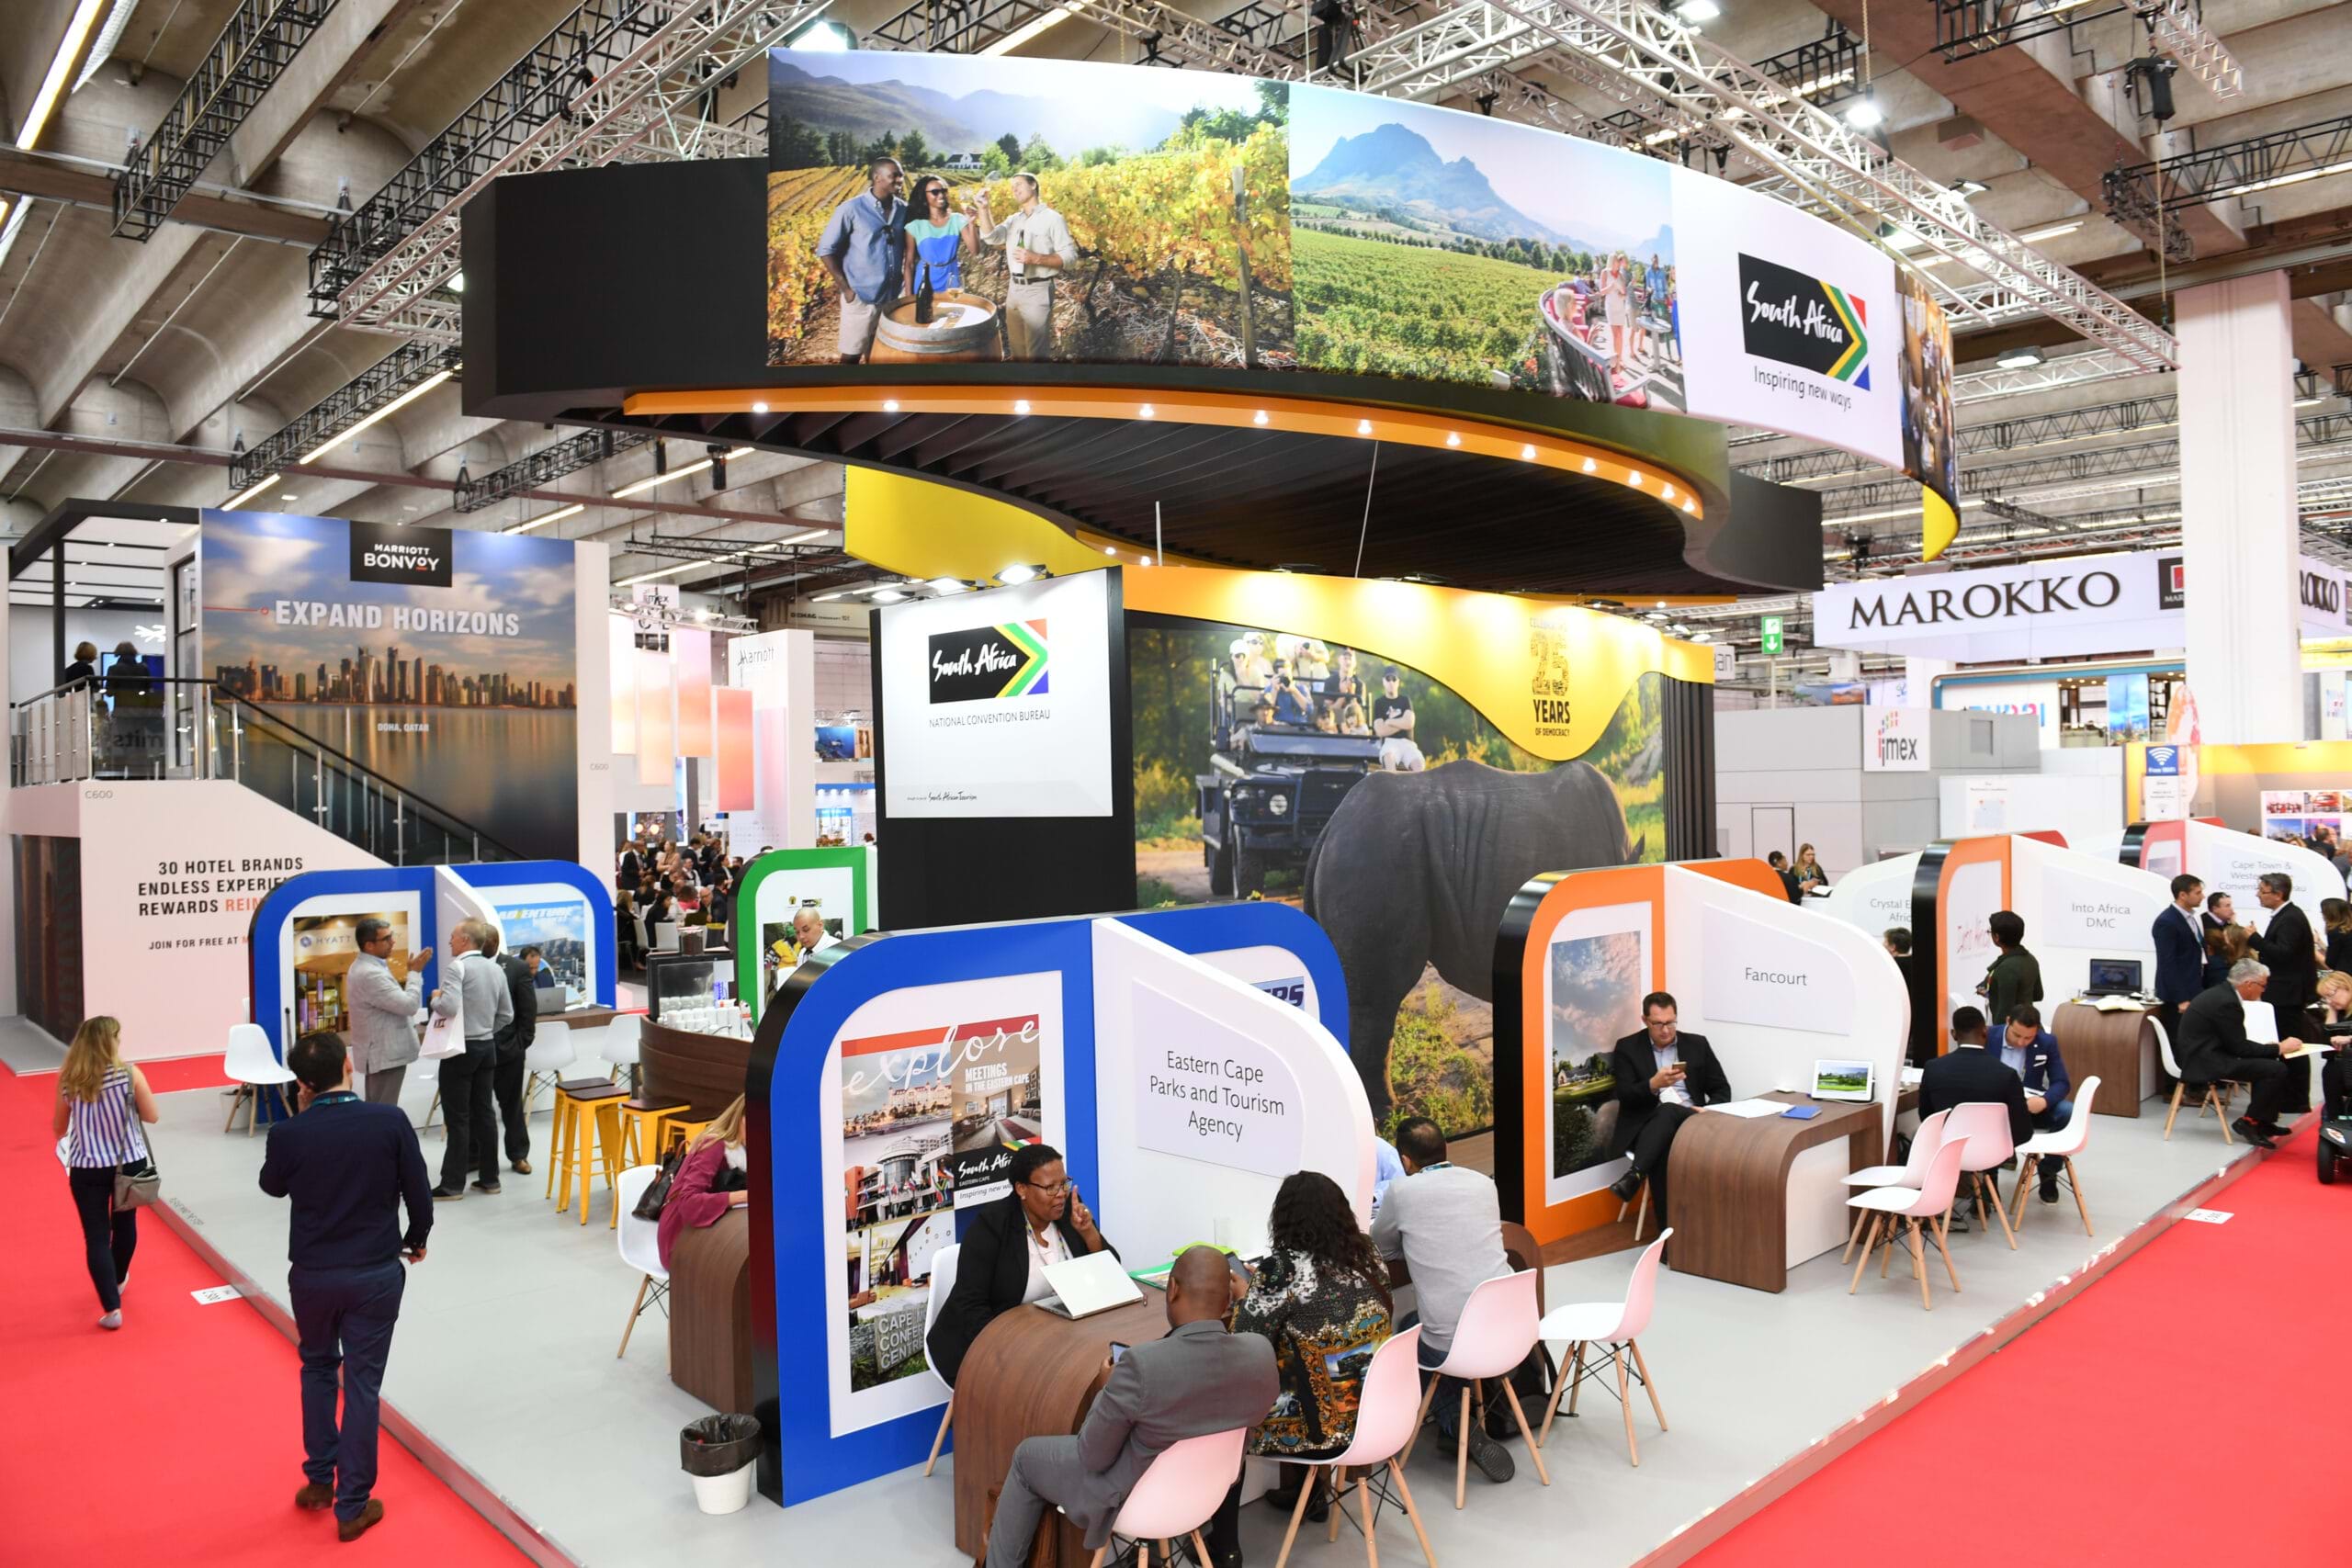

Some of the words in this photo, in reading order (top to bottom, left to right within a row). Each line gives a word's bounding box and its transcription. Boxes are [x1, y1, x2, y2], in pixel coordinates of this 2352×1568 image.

[1747, 280, 1802, 329] South
[1803, 299, 1843, 344] Africa
[1754, 366, 1805, 399] Inspiring
[1808, 383, 1828, 400] new
[1830, 391, 1851, 412] ways
[374, 544, 430, 555] MARRIOTT
[364, 553, 439, 571] BONVOY
[1849, 571, 2121, 629] MAROKKO
[276, 600, 382, 628] EXPAND
[393, 606, 520, 636] HORIZONS
[933, 648, 973, 682] South
[974, 643, 1017, 675] Africa
[929, 717, 966, 728] NATIONAL
[967, 712, 1017, 726] CONVENTION
[1019, 709, 1050, 721] BUREAU
[1532, 699, 1570, 724] YEARS
[1535, 728, 1542, 736] OF
[1543, 728, 1570, 737] DEMOCRACY
[85, 790, 114, 799] C600
[158, 862, 178, 874] 30
[186, 860, 235, 874] HOTEL
[242, 857, 303, 872] BRANDS
[2232, 861, 2256, 870] Cape
[2257, 861, 2282, 869] Town
[2285, 861, 2292, 870] &
[138, 880, 210, 896] ENDLESS
[139, 899, 219, 916] REWARDS
[1870, 898, 1902, 910] Crystal
[2072, 903, 2095, 913] Into
[2097, 904, 2131, 915] Africa
[1888, 912, 1911, 922] Afric
[2086, 917, 2116, 928] DMC
[149, 940, 172, 950] JOIN
[176, 939, 196, 948] FOR
[199, 937, 223, 947] FREE
[227, 936, 238, 944] AT
[316, 935, 352, 945] HYATT
[1746, 967, 1807, 986] Fancourt
[842, 1020, 1040, 1096] explore
[965, 1063, 1008, 1082] MEETINGS
[1167, 1050, 1219, 1076] Eastern
[1224, 1059, 1263, 1086] Cape
[965, 1082, 973, 1094] IN
[974, 1080, 986, 1092] THE
[987, 1076, 1013, 1090] EASTERN
[1013, 1073, 1030, 1085] CAPE
[1150, 1076, 1186, 1098] Parks
[1191, 1086, 1217, 1104] and
[1222, 1088, 1284, 1116] Tourism
[1188, 1111, 1243, 1143] Agency
[958, 1157, 989, 1179] South
[990, 1153, 1013, 1171] Afri
[959, 1187, 987, 1200] Inspiring
[988, 1185, 1002, 1193] new
[878, 1313, 912, 1334] CAPE
[879, 1325, 924, 1351] CONFER
